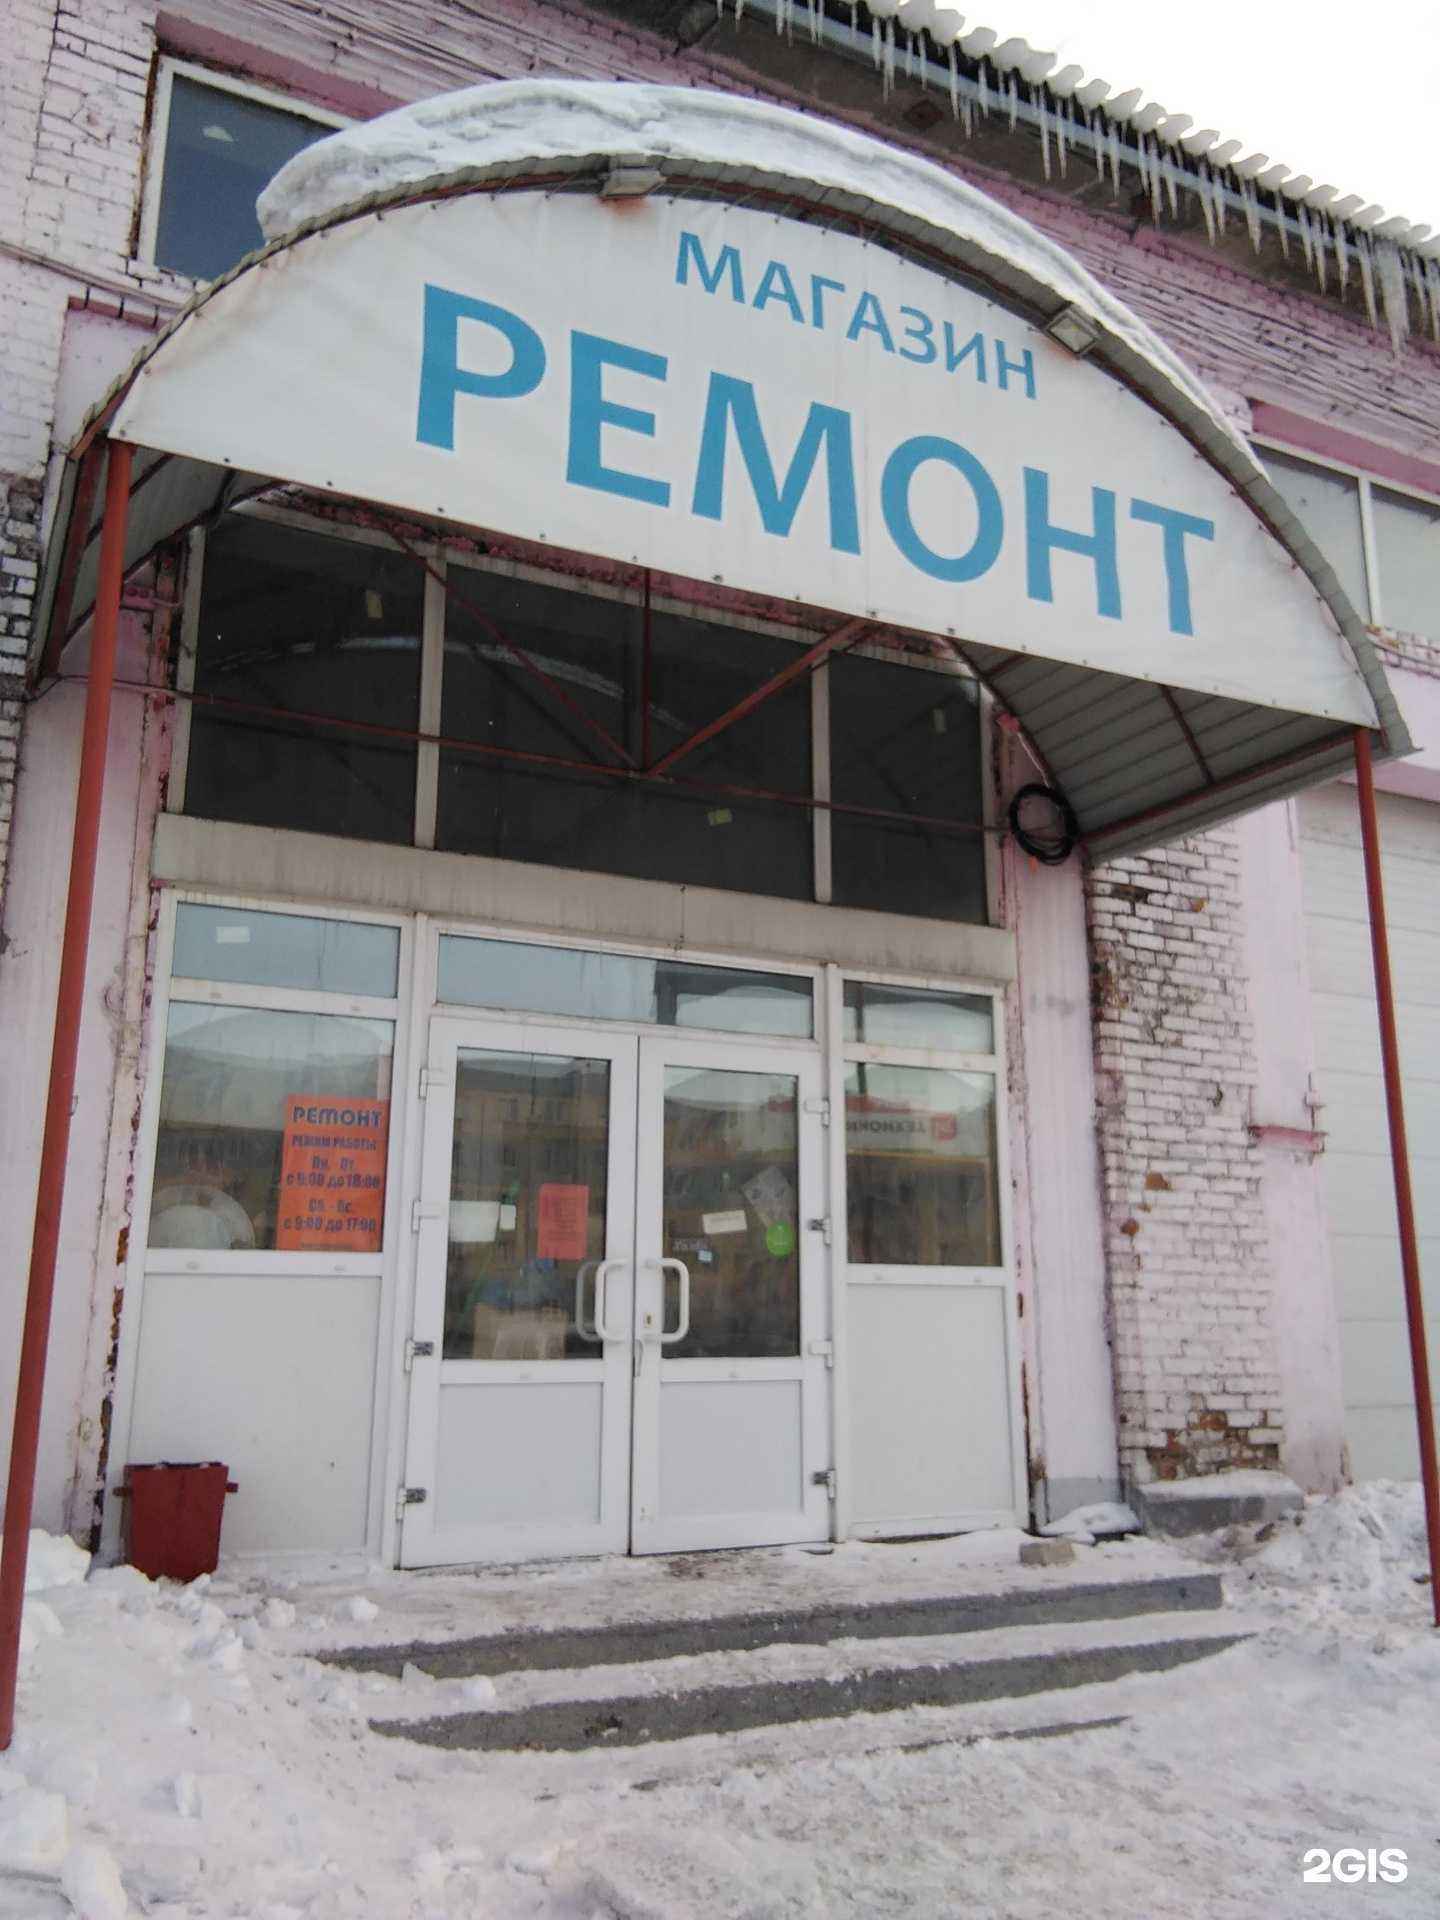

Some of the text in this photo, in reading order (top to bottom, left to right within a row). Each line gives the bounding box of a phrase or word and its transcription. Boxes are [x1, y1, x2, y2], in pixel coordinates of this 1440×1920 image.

[675, 231, 1037, 399] МАГАЗИН
[416, 283, 1215, 637] РЕМОНТ
[293, 1106, 382, 1127] РЕМОНТ
[327, 1177, 344, 1188] до
[325, 1218, 343, 1232] до
